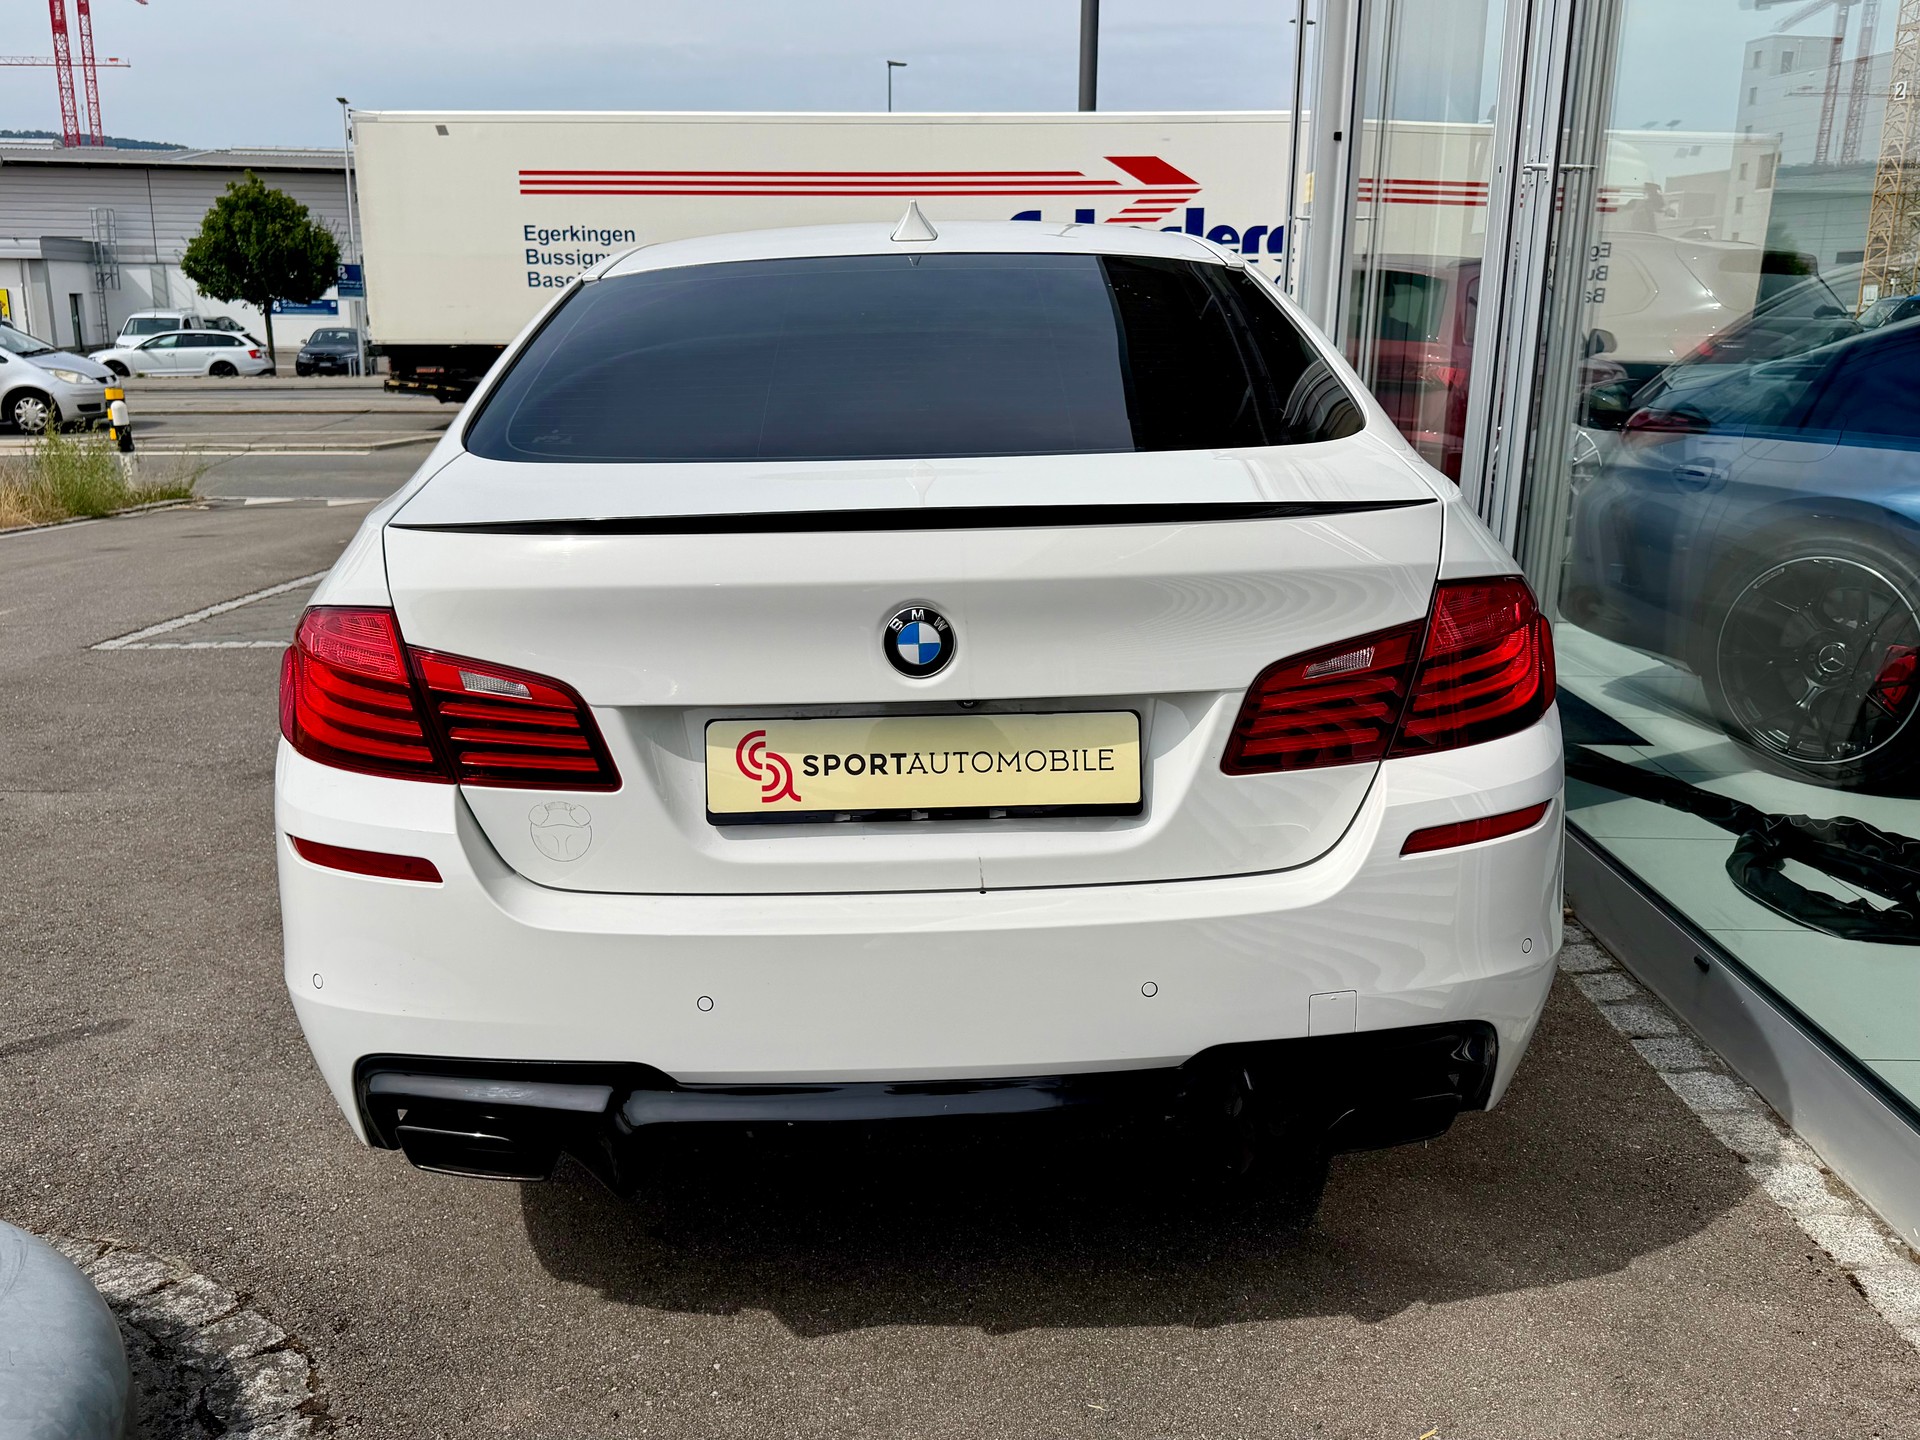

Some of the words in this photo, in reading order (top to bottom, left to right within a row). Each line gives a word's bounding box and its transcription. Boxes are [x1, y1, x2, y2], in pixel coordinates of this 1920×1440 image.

[1895, 83, 1905, 98] 2
[524, 225, 635, 246] Egerkingen
[525, 249, 610, 269] Bussign
[889, 609, 949, 633] BMW
[802, 749, 1115, 777] SPORTAUTOMOBILE
